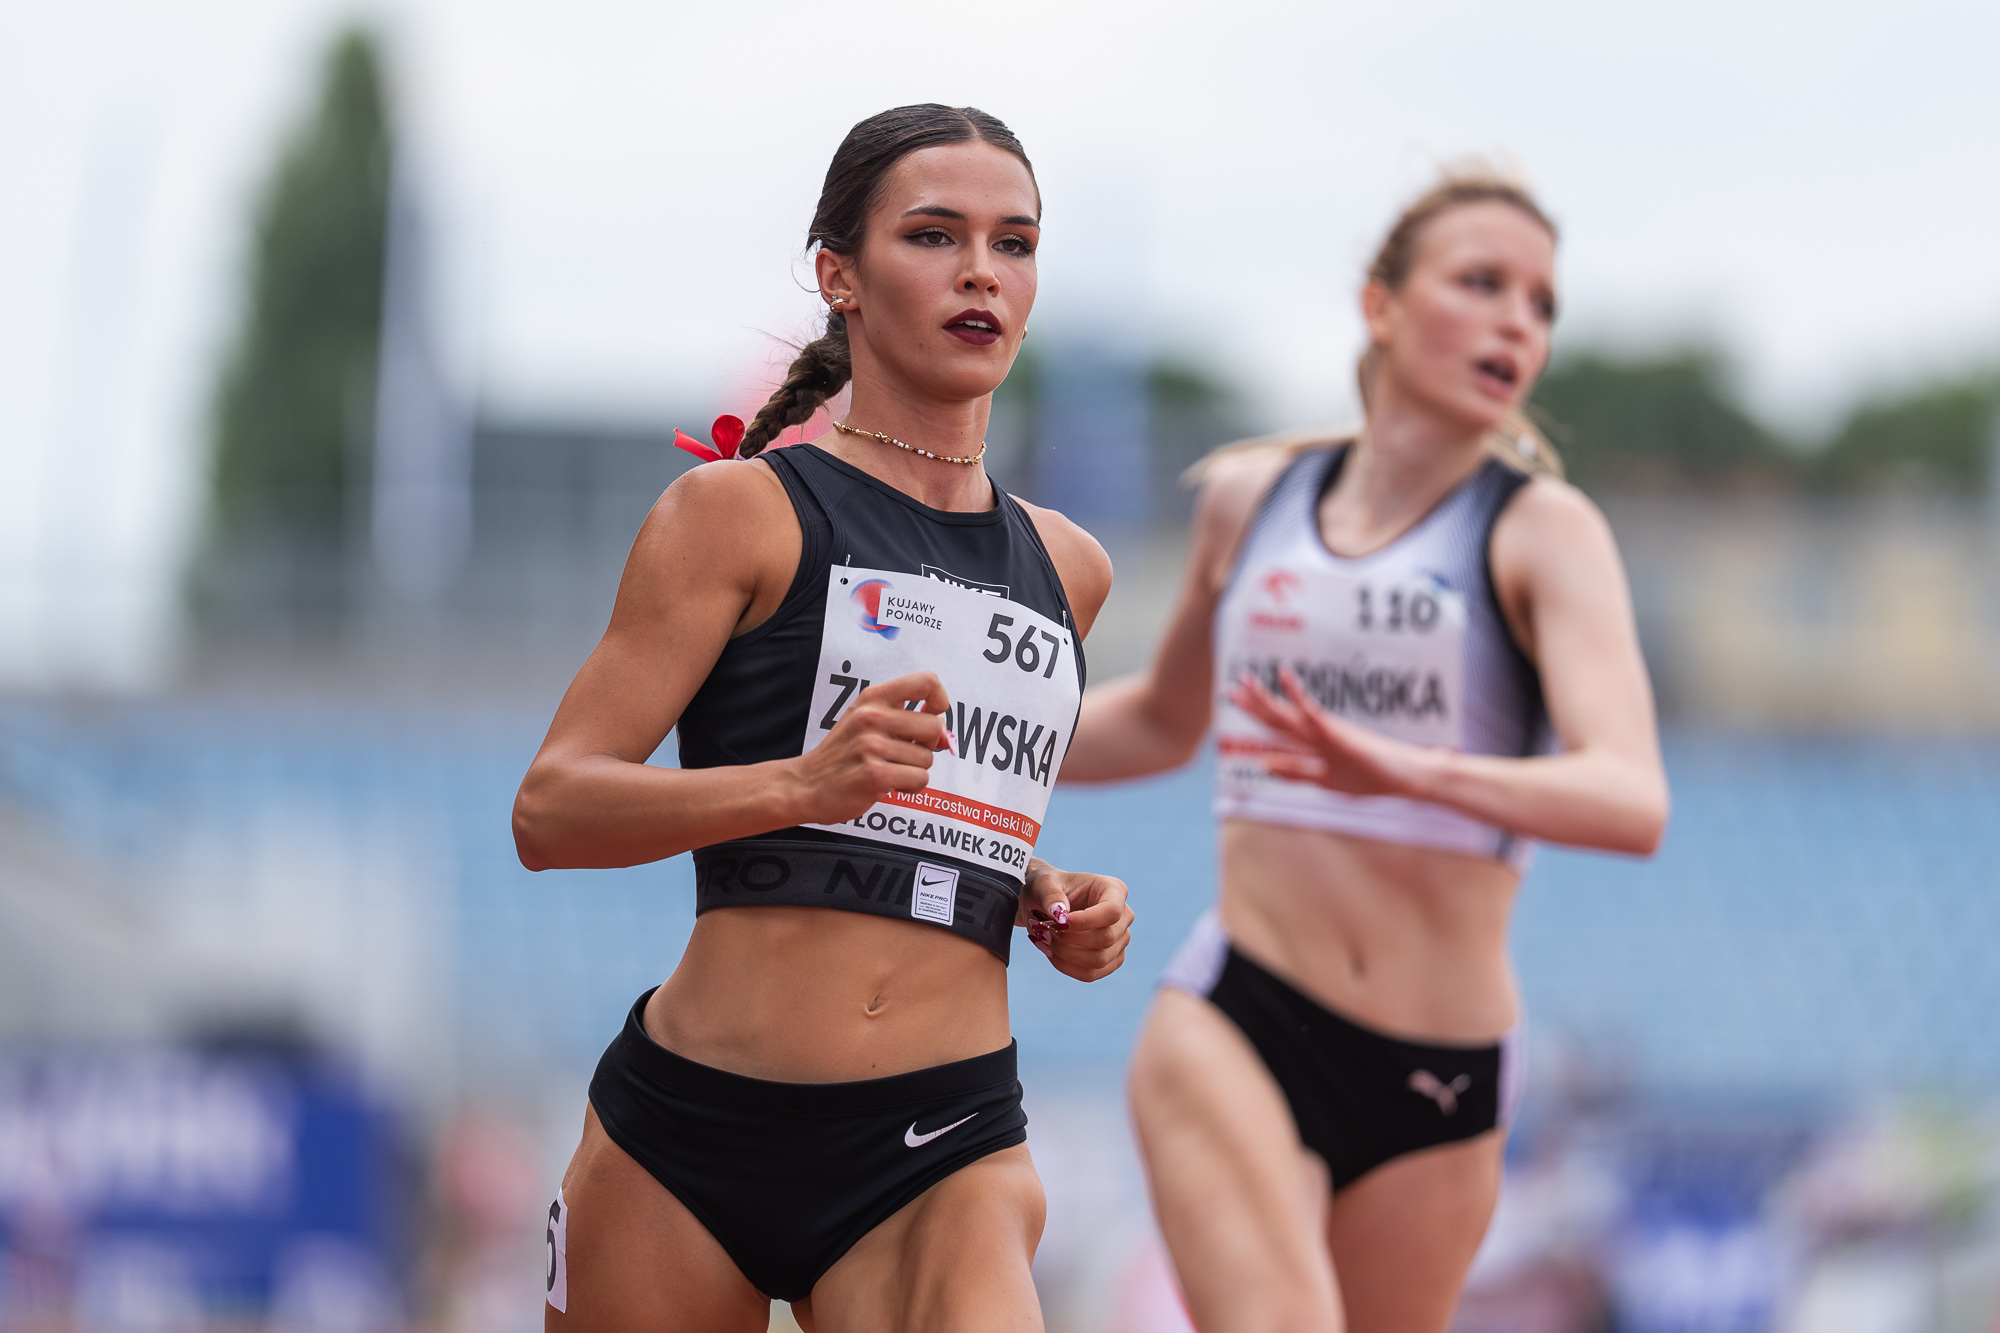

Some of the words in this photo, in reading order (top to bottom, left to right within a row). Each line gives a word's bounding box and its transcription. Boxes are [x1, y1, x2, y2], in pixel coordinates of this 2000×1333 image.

[885, 608, 943, 631] POMORZE
[887, 596, 936, 614] KUJAWY
[1356, 584, 1442, 634] 110
[982, 612, 1060, 679] 567
[820, 660, 1057, 787] ŻWSKA
[840, 811, 985, 857] ŁOCŁAWEK
[988, 841, 1026, 870] 2025
[983, 810, 1020, 831] Polski
[1022, 822, 1034, 838] U20
